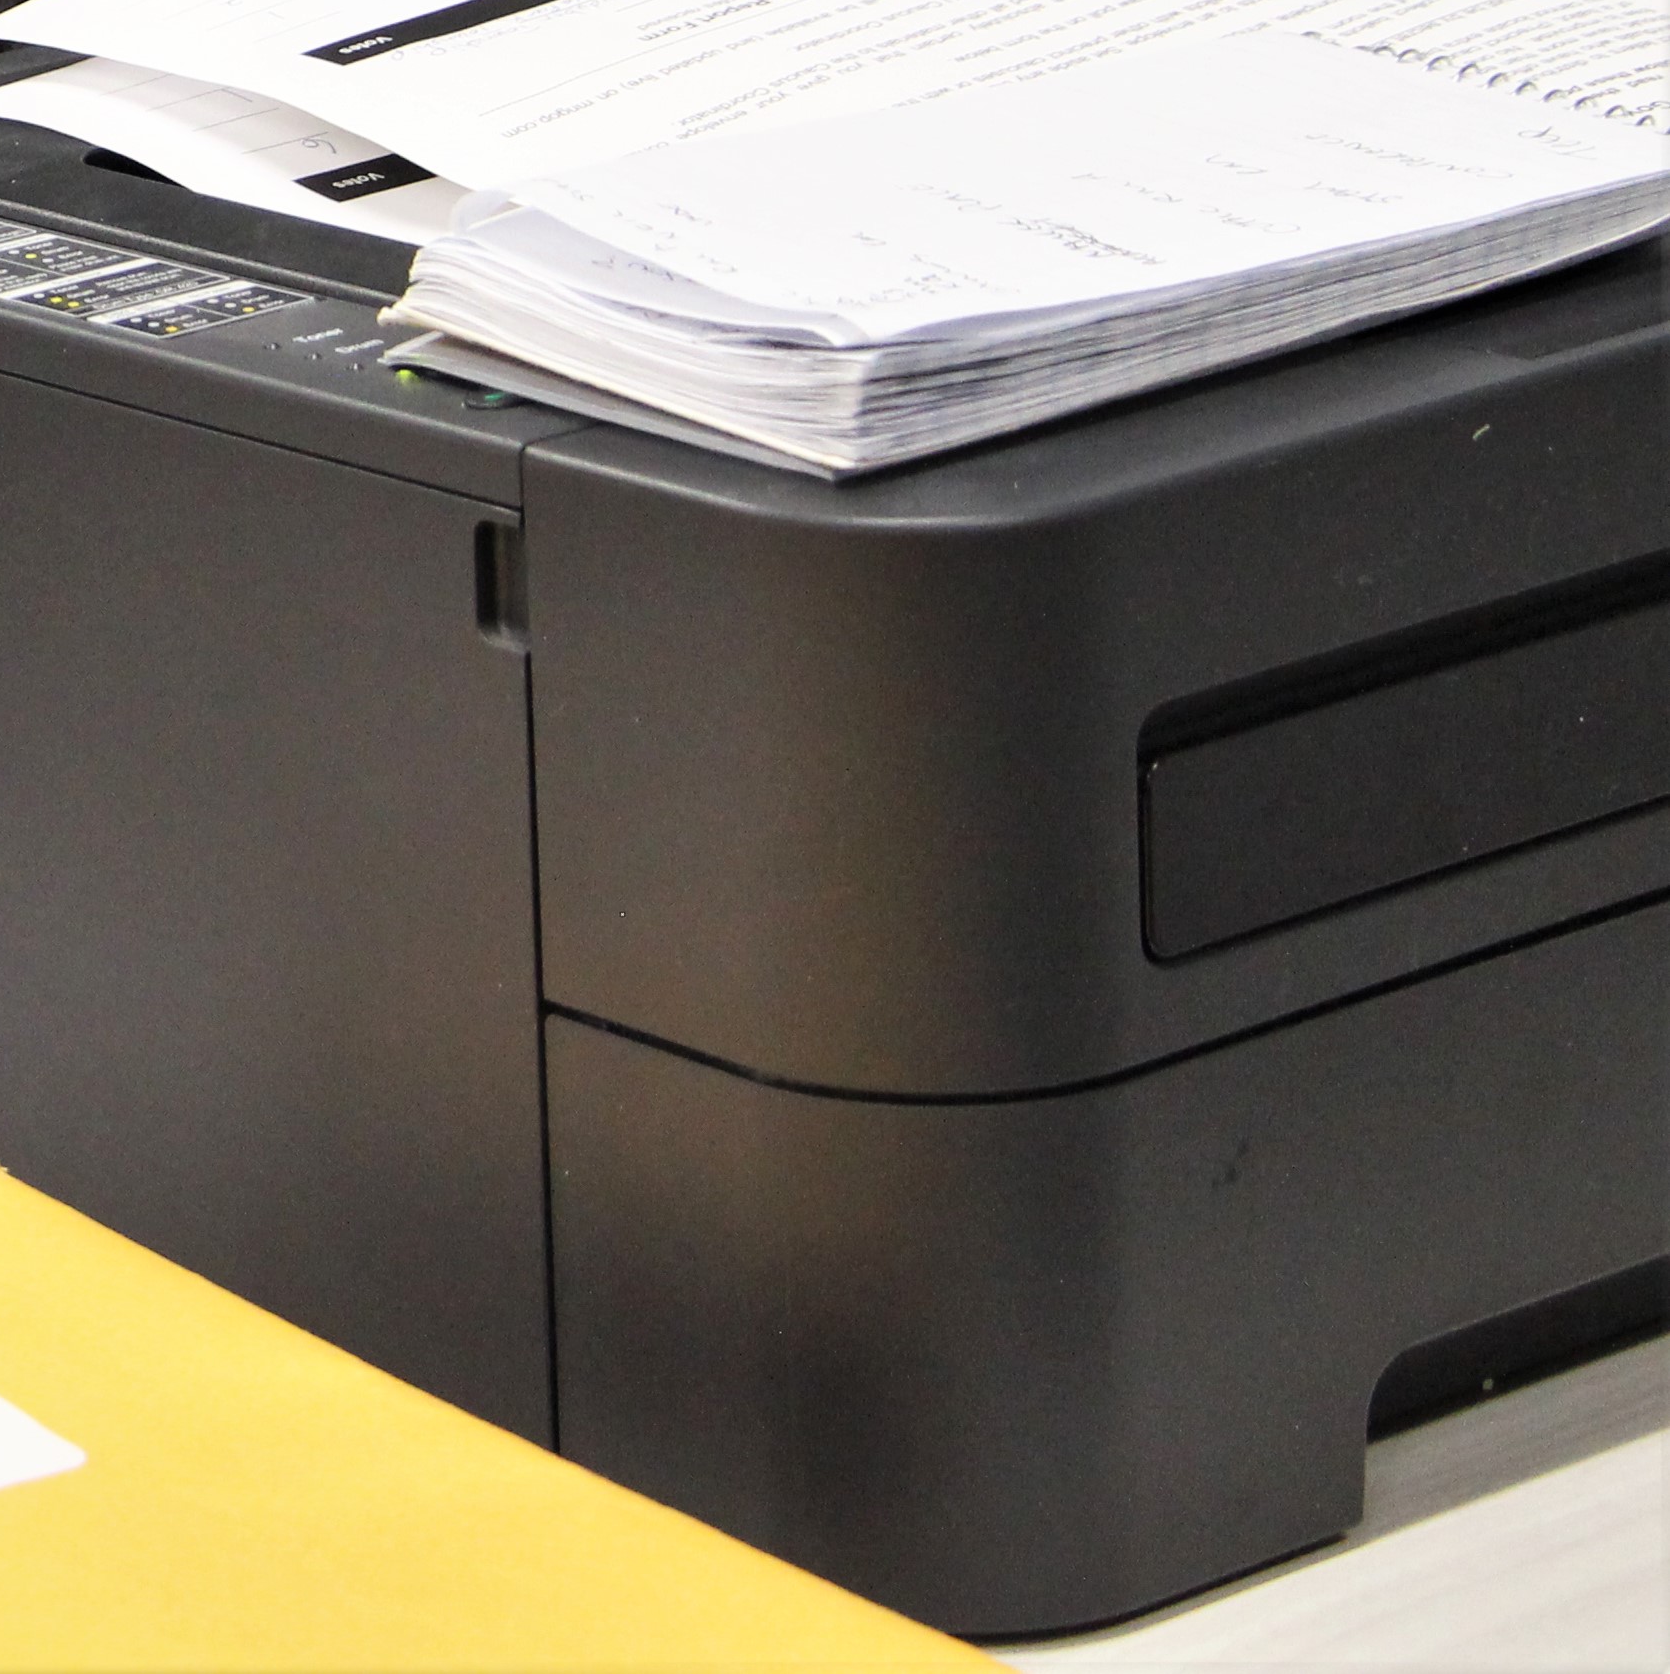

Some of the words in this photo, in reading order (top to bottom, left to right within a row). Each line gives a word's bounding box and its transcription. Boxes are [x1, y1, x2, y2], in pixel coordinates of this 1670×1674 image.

[638, 21, 699, 41] Form
[340, 35, 392, 58] Votes
[658, 49, 723, 76] updated
[619, 73, 660, 90] live)
[768, 63, 831, 88] Caucus
[796, 74, 832, 91] give
[678, 87, 785, 127] Coordinator.
[756, 90, 790, 109] your
[501, 99, 595, 138] mngop.com
[675, 110, 748, 140] envelope
[331, 170, 385, 193] Votes
